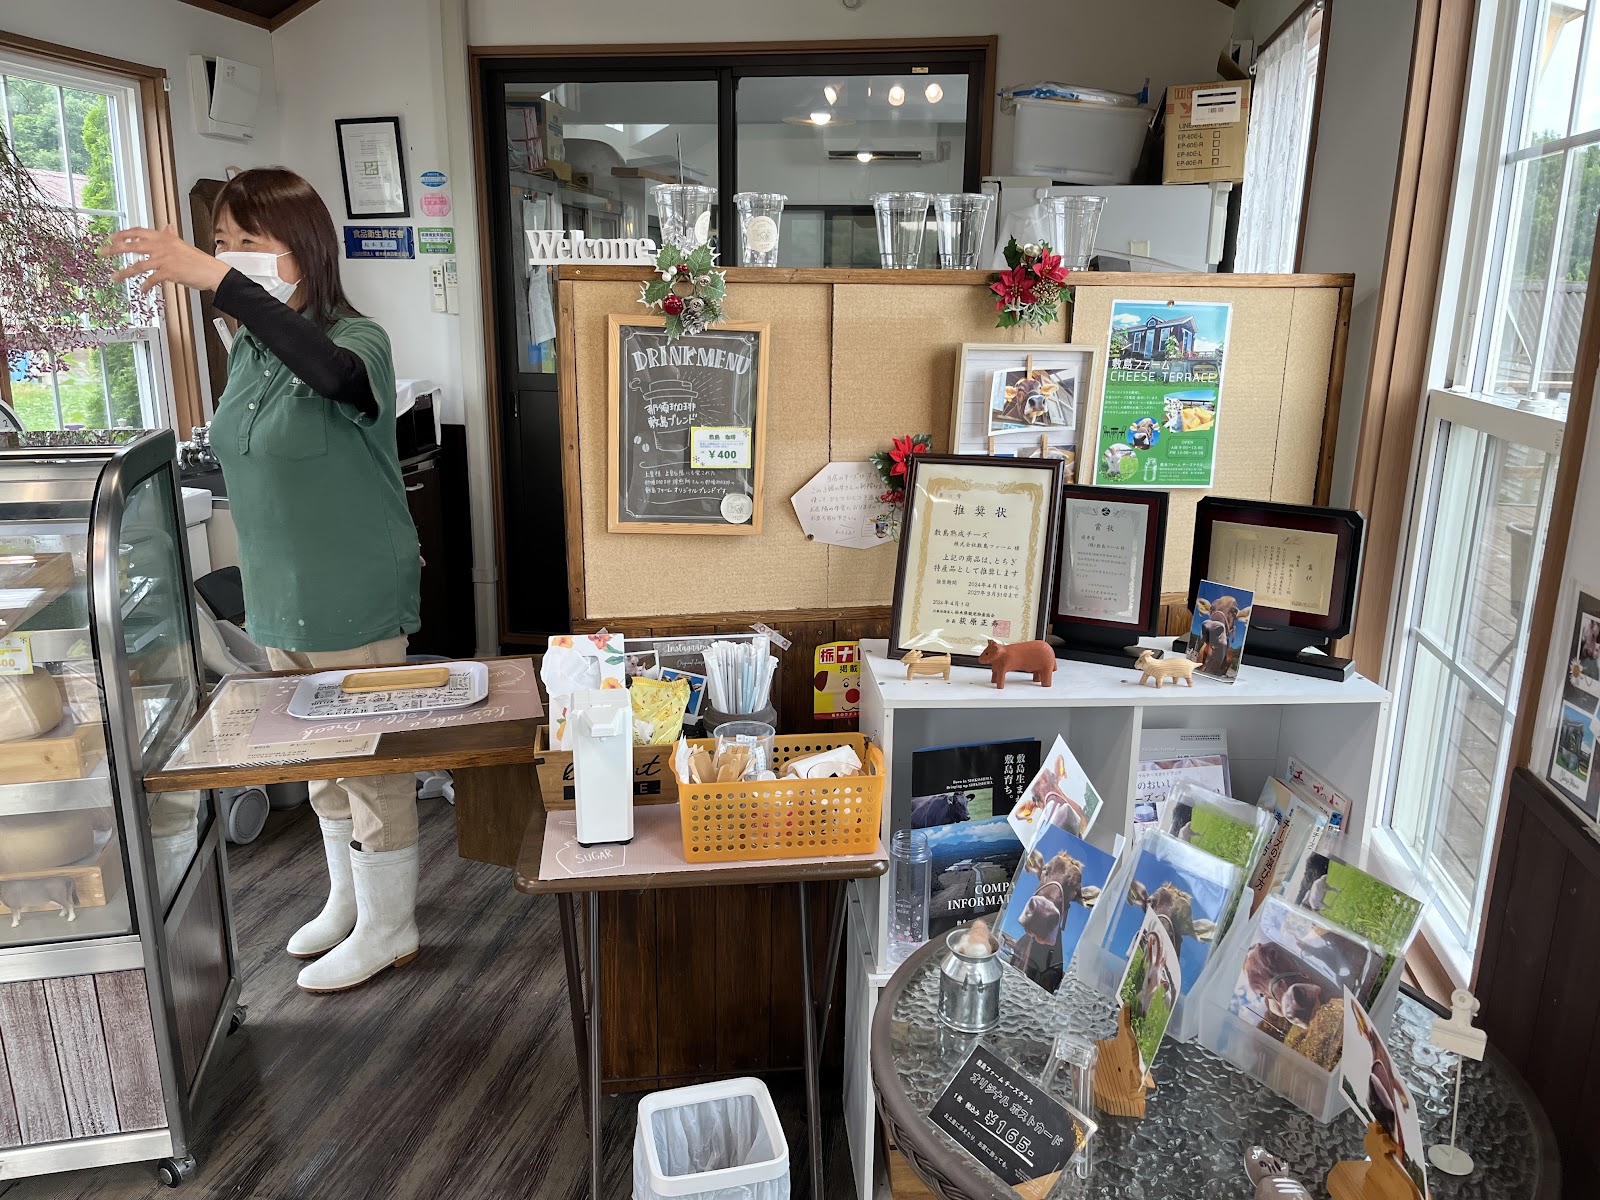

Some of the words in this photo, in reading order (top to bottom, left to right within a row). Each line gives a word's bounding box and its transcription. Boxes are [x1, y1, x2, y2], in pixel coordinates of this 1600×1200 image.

[353, 229, 404, 239] 食品衛生責任者
[525, 229, 657, 260] Welcome
[631, 345, 697, 372] DRINK
[695, 347, 752, 375] MENU
[1111, 358, 1170, 370] 敷島ファーム
[1110, 371, 1156, 382] CHEESE
[1161, 372, 1215, 383] TERRACE
[708, 450, 737, 459] ¥400
[953, 504, 1008, 518] 推奨状
[942, 554, 1018, 566] 上記の商品は、とちぎ
[933, 563, 1019, 577] 特産品として推奨します
[820, 646, 861, 664] 栃ナ
[839, 664, 858, 674] 掲載
[299, 720, 362, 740] Break
[575, 848, 614, 864] SUGAR
[969, 1072, 1010, 1108] オリジナル
[1004, 1080, 1034, 1106] チーズテラス
